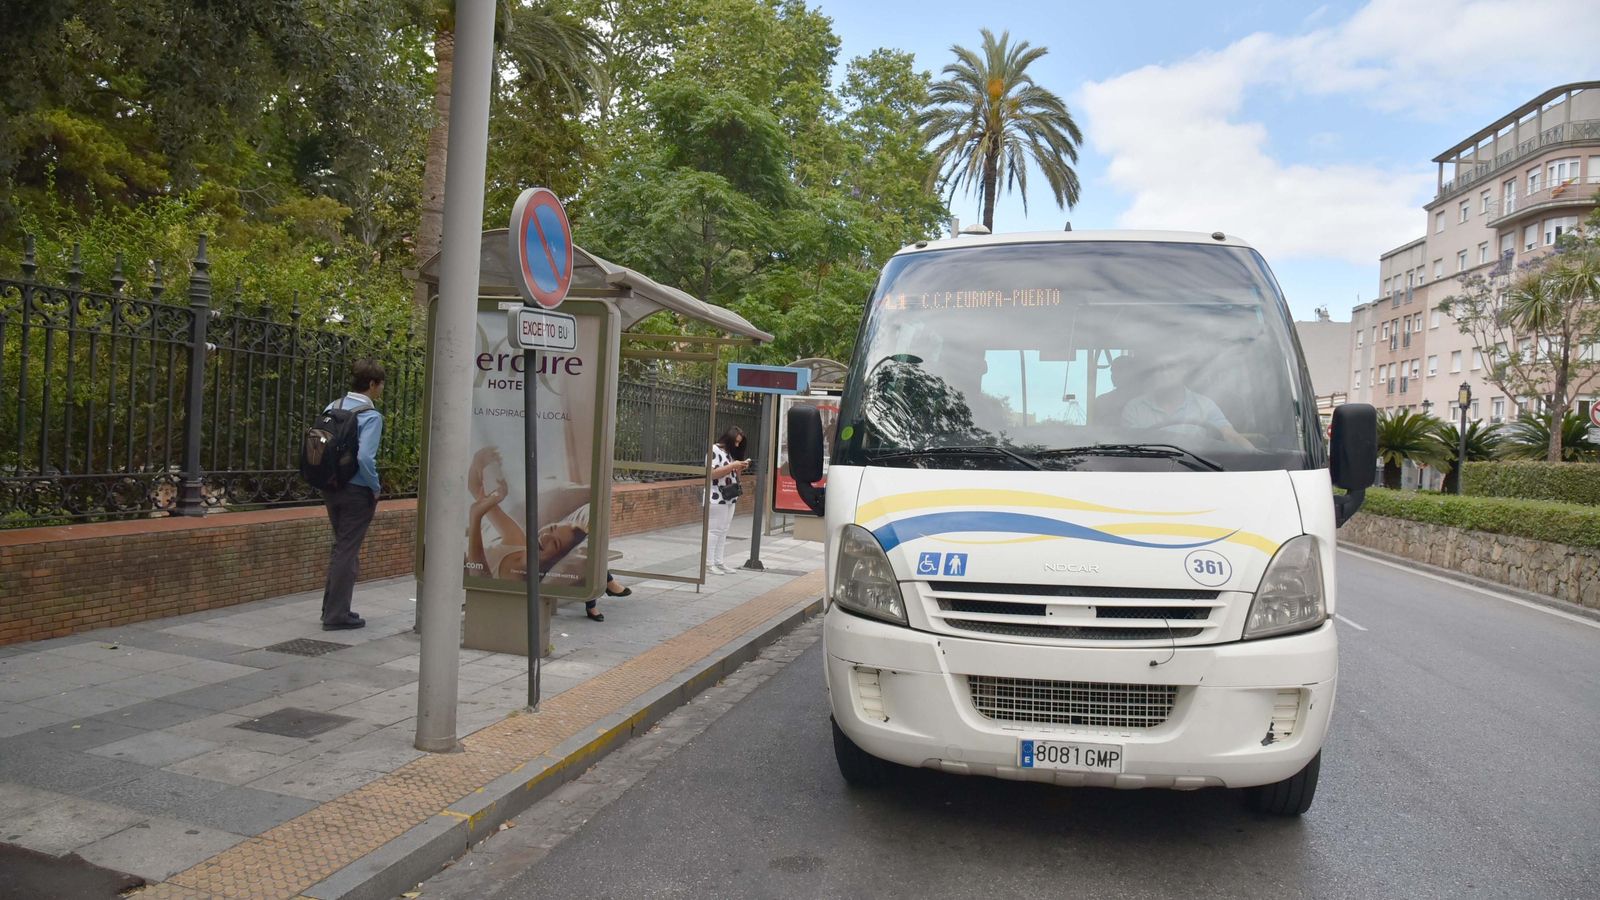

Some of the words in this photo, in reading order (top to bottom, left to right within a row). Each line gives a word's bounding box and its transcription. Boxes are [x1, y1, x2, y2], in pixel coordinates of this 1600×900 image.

[558, 326, 569, 339] BU
[476, 351, 583, 376] ercure
[488, 379, 523, 390] HOTE
[485, 408, 541, 418] INSPIRACN
[542, 411, 572, 421] LOCAL
[1193, 558, 1225, 576] 361
